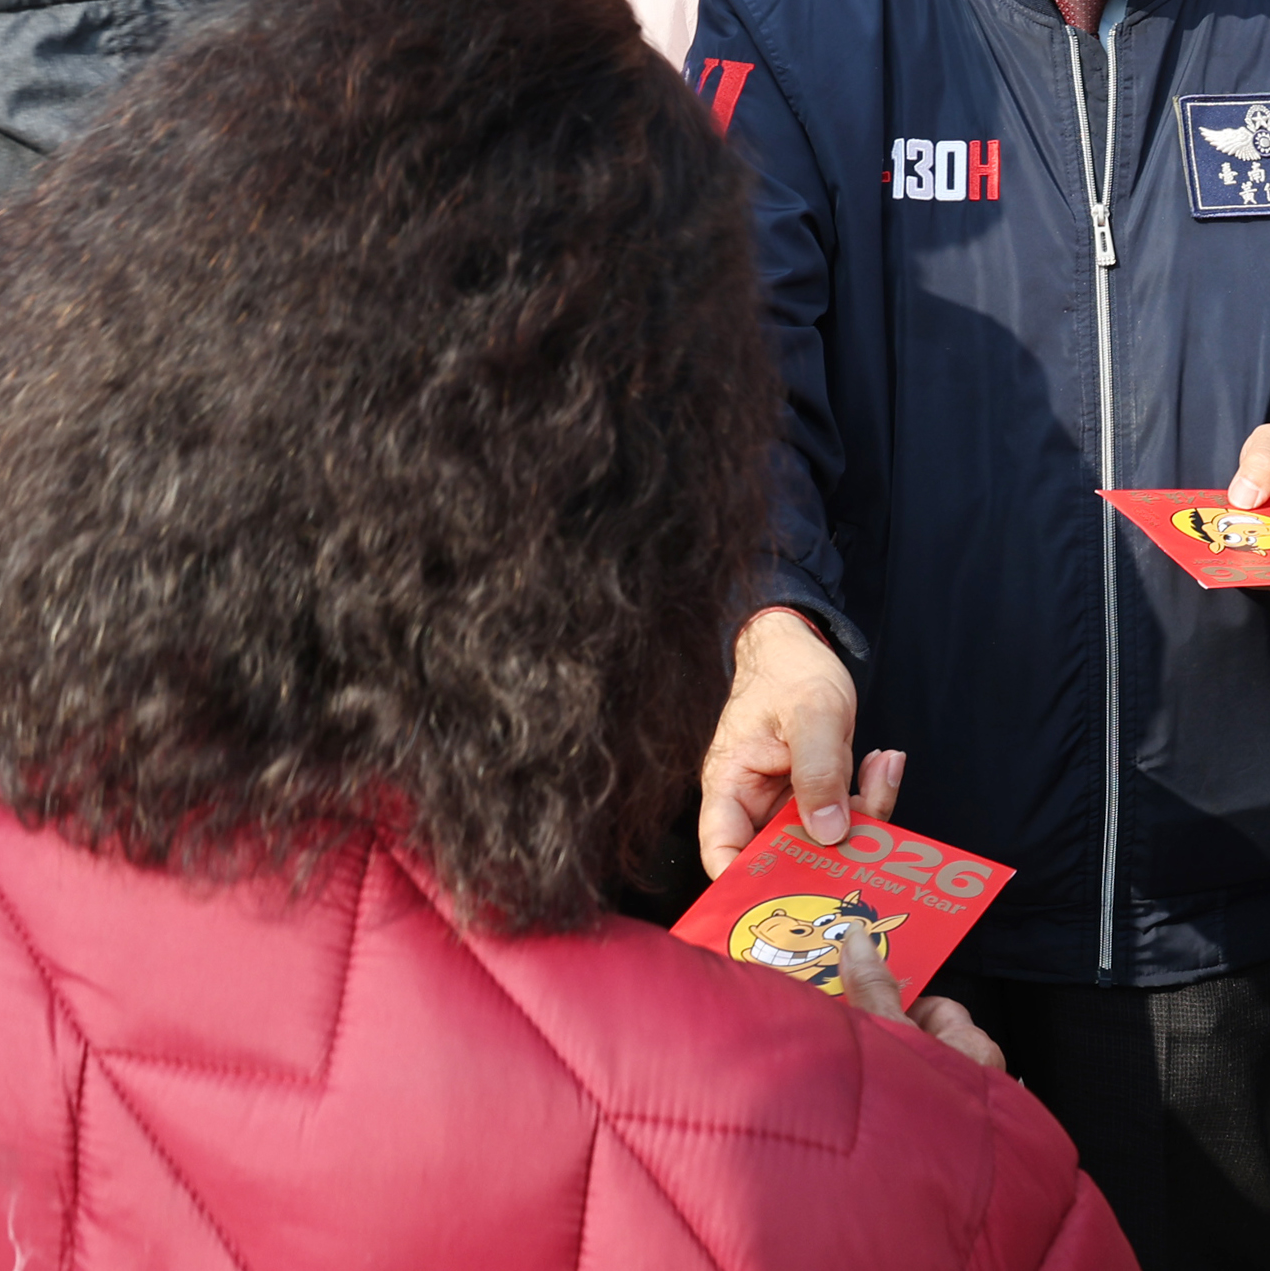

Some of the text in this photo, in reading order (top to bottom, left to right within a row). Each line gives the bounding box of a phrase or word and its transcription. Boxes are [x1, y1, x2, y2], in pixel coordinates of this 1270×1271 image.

[769, 834, 967, 915] Happy New Year
